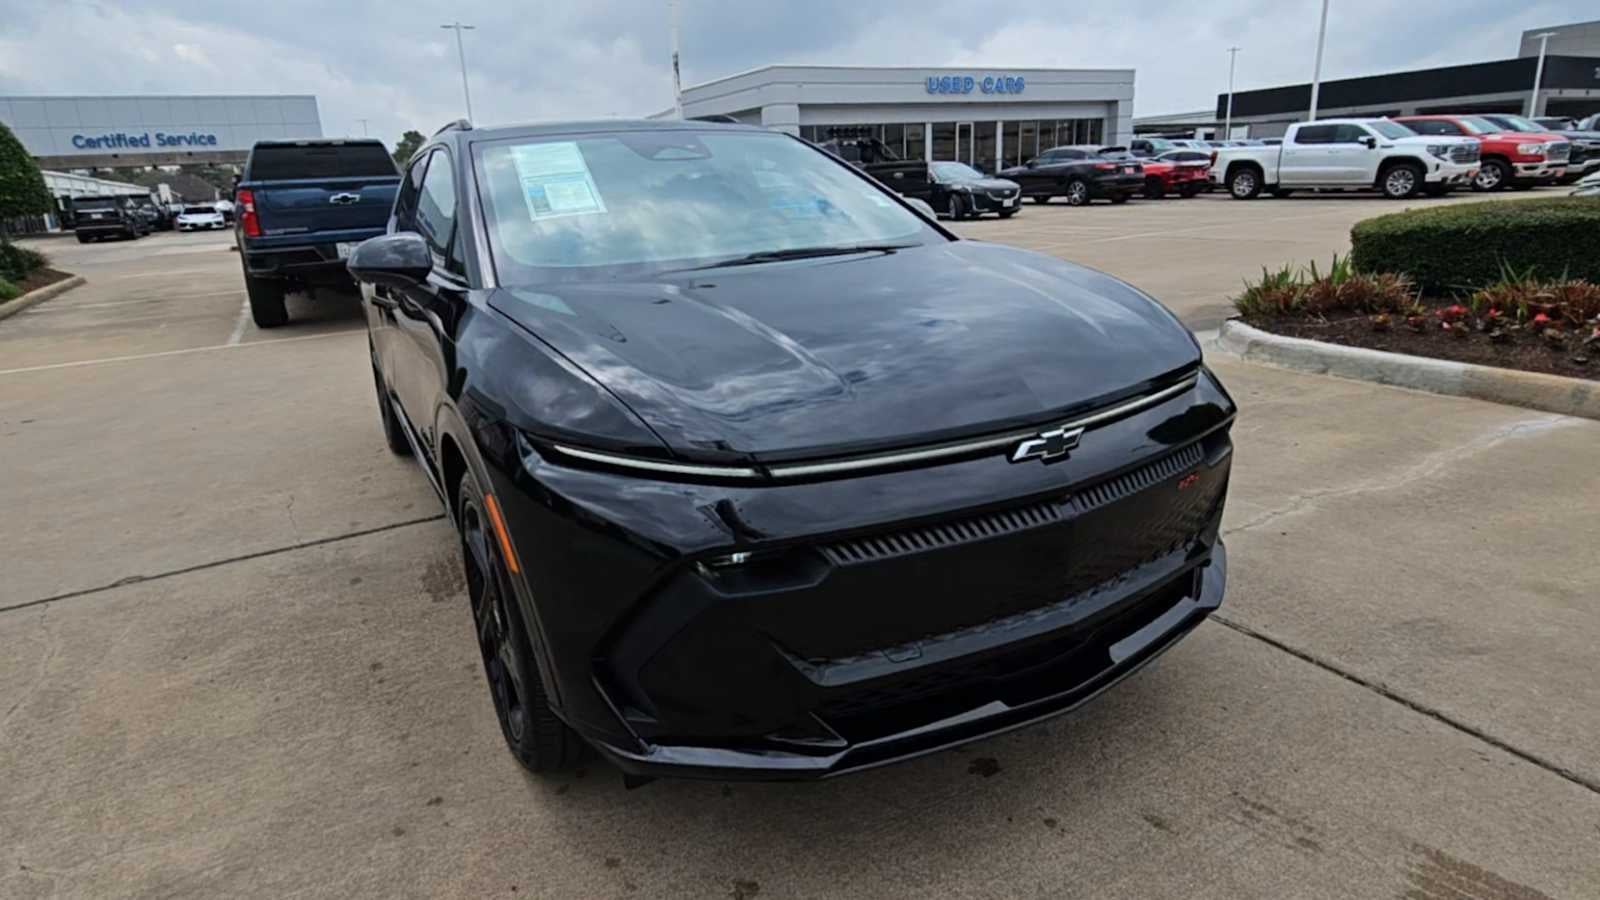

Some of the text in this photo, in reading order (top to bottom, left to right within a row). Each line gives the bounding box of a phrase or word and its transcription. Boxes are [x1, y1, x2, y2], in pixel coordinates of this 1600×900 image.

[927, 75, 1025, 95] USED CARS
[72, 131, 217, 149] Certified Service
